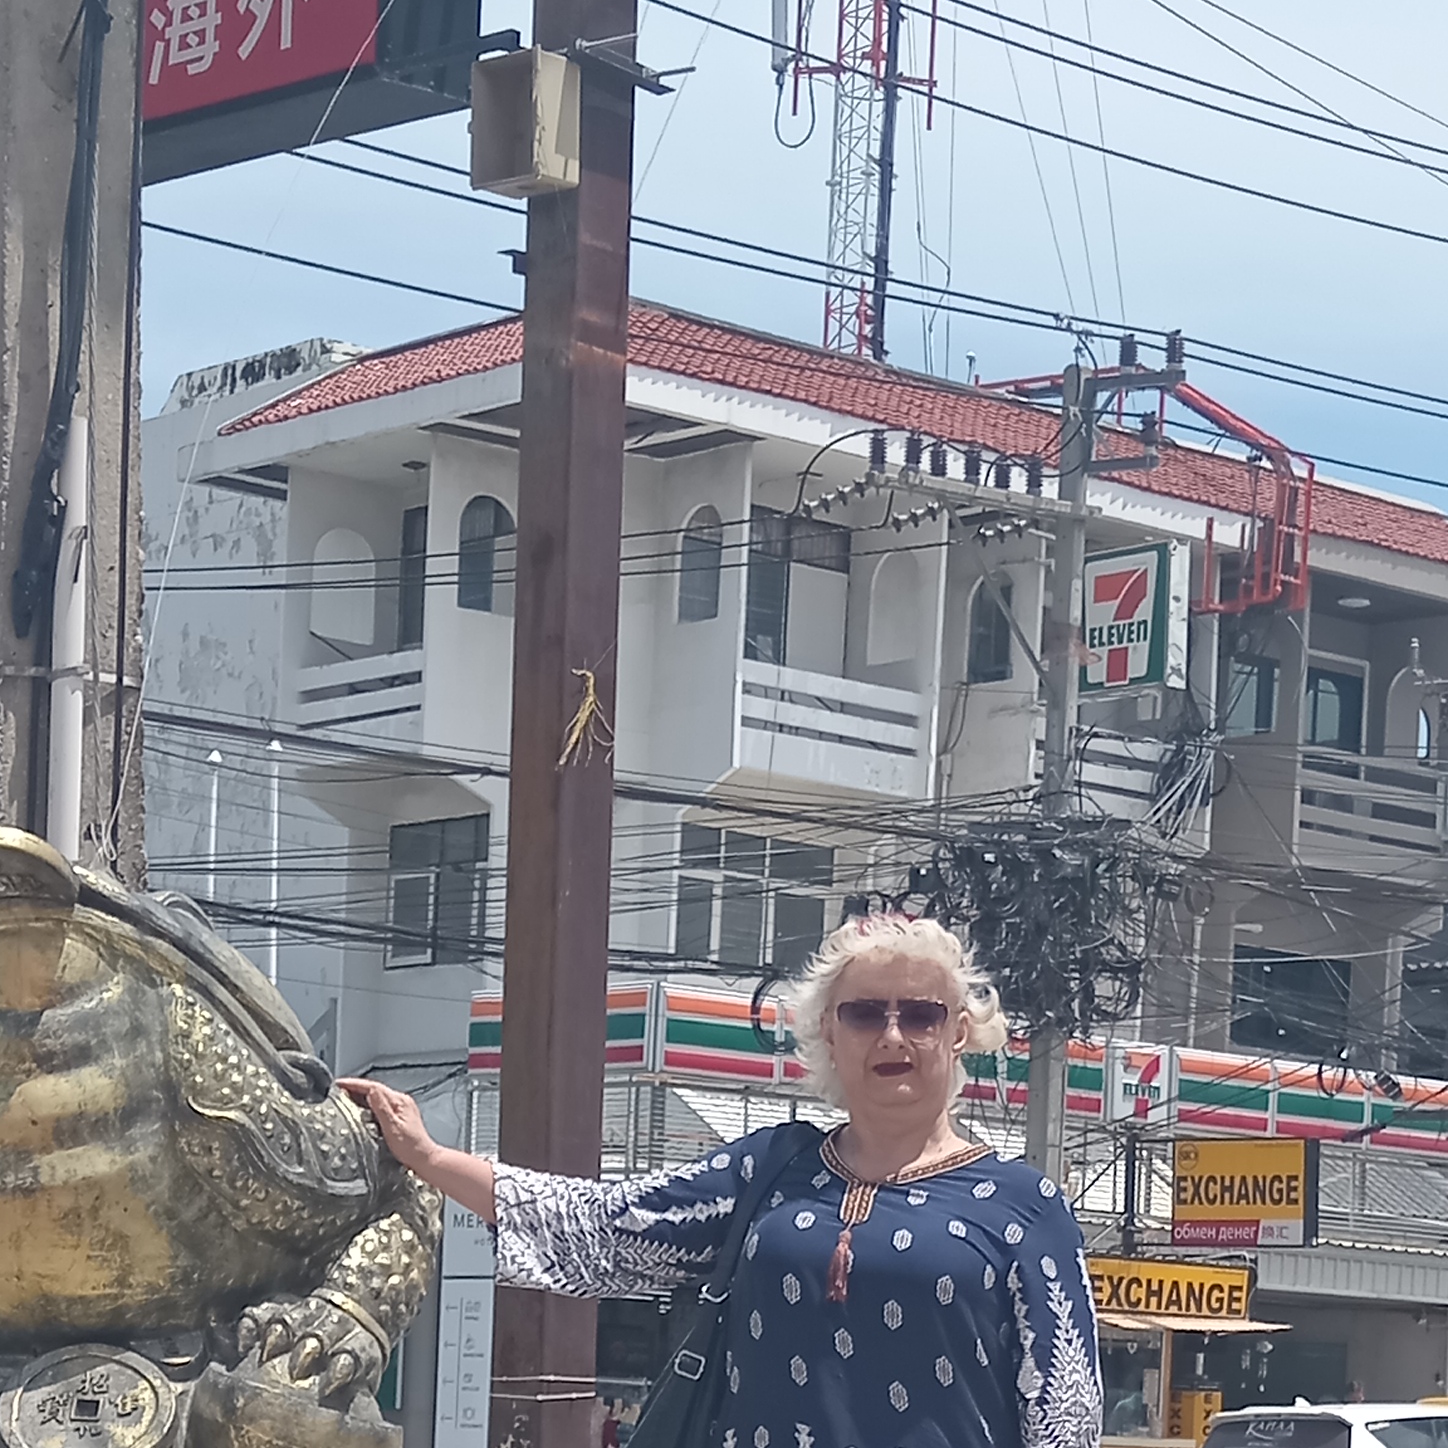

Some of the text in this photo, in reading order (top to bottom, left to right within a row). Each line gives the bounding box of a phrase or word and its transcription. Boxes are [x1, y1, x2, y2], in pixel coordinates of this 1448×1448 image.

[1175, 1174, 1300, 1207] EXCHANGE
[452, 1213, 486, 1229] MER
[1173, 1223, 1257, 1241] обмен денег
[1089, 1274, 1244, 1316] EXCHANGE
